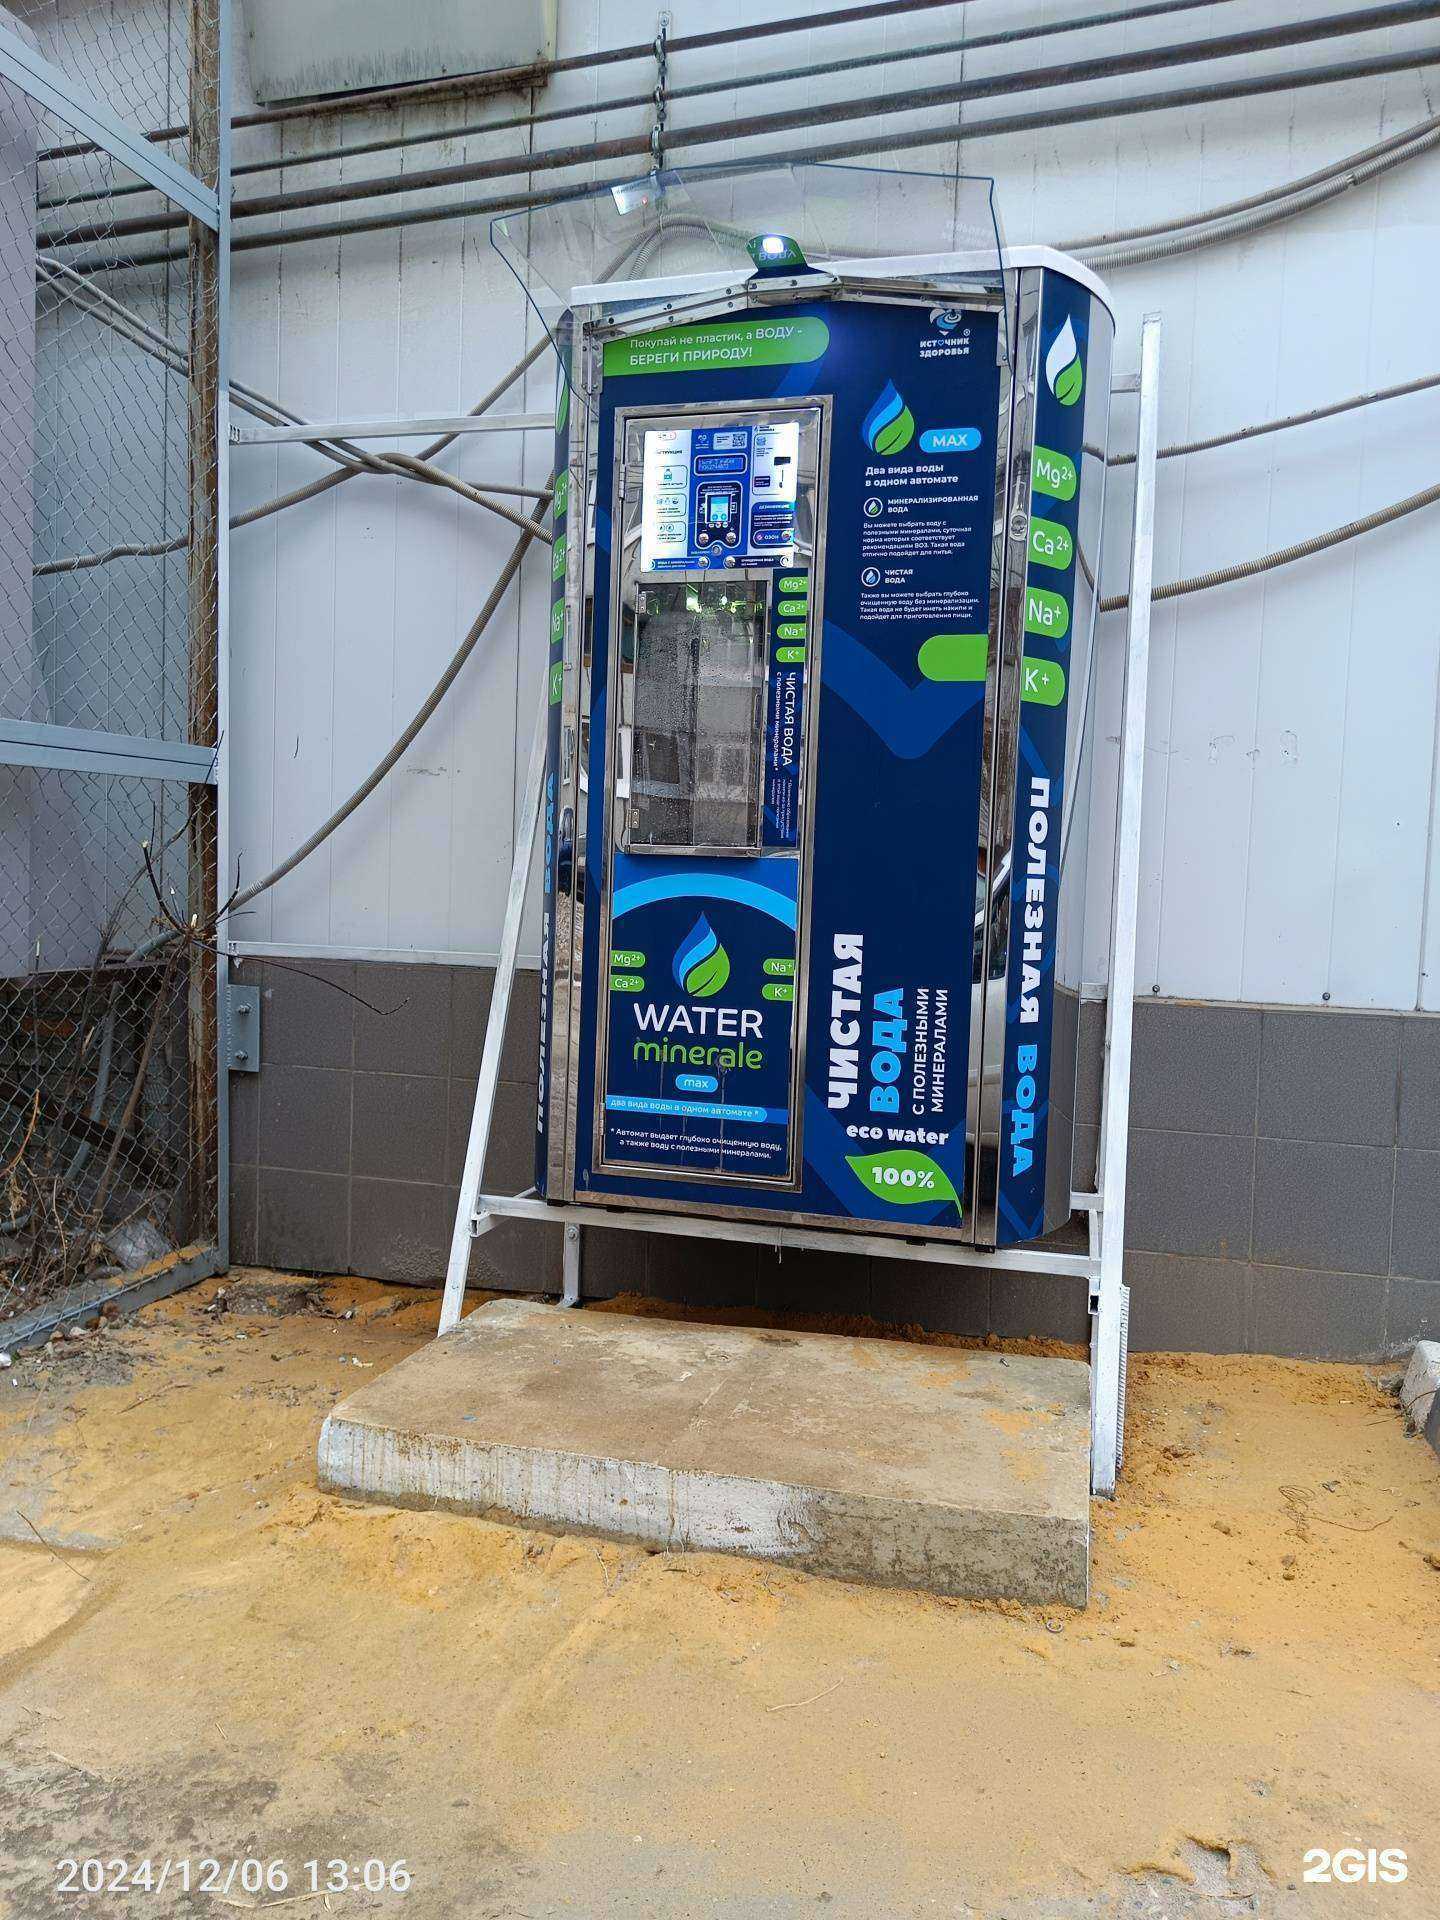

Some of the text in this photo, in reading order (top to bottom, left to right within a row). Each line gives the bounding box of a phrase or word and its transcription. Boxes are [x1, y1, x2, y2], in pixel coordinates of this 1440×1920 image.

[630, 336, 676, 349] Покупай
[696, 332, 743, 344] пластик,
[756, 326, 794, 340] ВОДУ
[630, 348, 753, 365] БЕРЕГИ ПРИРОДУ!
[919, 347, 970, 358] ЗДОРОВЬЯ
[932, 434, 968, 448] MAX
[866, 464, 944, 476] Два вида воды
[874, 478, 907, 487] одном
[910, 476, 958, 485] автомате
[888, 496, 979, 505] МИНЕРАЛИЗИРОВАННАЯ
[781, 672, 796, 766] ЧИСТАЯ ВОДА
[544, 772, 554, 893] ВОДА
[1011, 776, 1050, 1177] ПОЛЕЗНАЯ ВОДА
[633, 1002, 763, 1039] WATER
[828, 933, 864, 1109] ЧИСТАЯ
[633, 1036, 763, 1070] minerale
[870, 988, 907, 1114] ВОДА
[913, 988, 929, 1115] С ПОЛЕЗНЫМИ
[931, 989, 948, 1113] МИНЕРАЛАМИ
[684, 1078, 709, 1089] max
[711, 1108, 753, 1117] автомате
[616, 1128, 648, 1138] Автомат
[680, 1135, 710, 1143] глубоко
[712, 1138, 759, 1148] очищенную
[761, 1142, 782, 1151] воду,
[847, 1125, 949, 1145] eco water
[676, 1145, 720, 1153] полезными
[721, 1149, 771, 1159] минералами.
[871, 1166, 934, 1189] 100%
